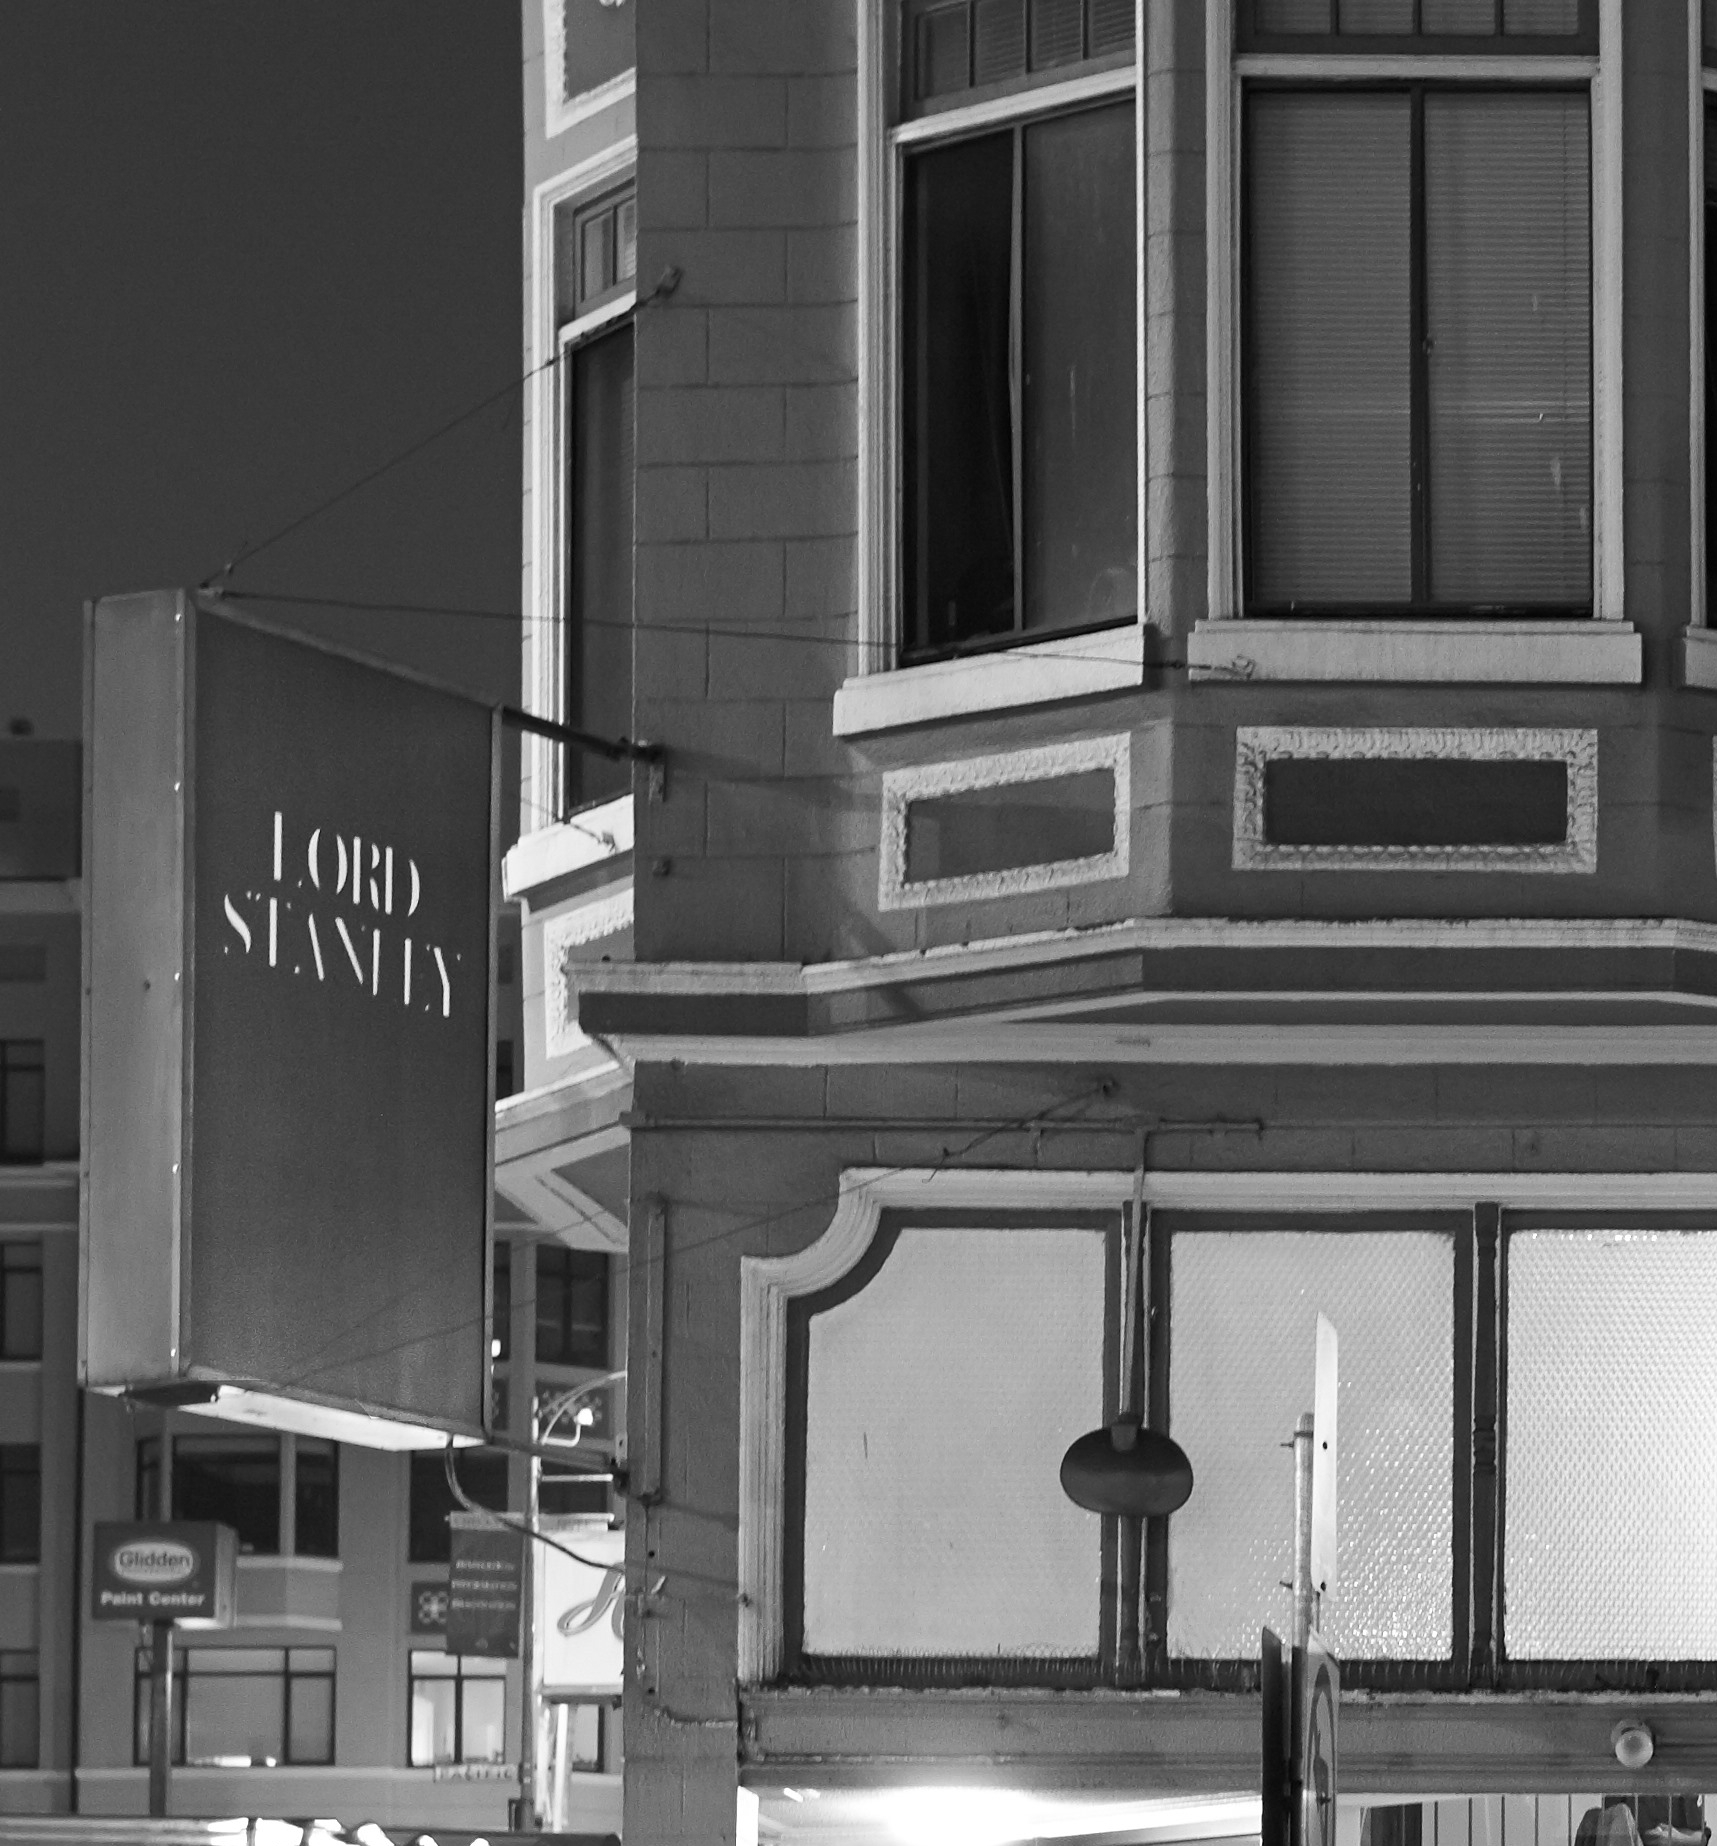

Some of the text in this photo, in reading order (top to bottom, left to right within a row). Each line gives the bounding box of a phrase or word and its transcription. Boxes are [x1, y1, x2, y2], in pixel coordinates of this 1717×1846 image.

[273, 810, 420, 918] LORD
[223, 892, 462, 1018] STANLEY
[119, 1550, 192, 1568] Glidden
[100, 1590, 205, 1607] Paint Center
